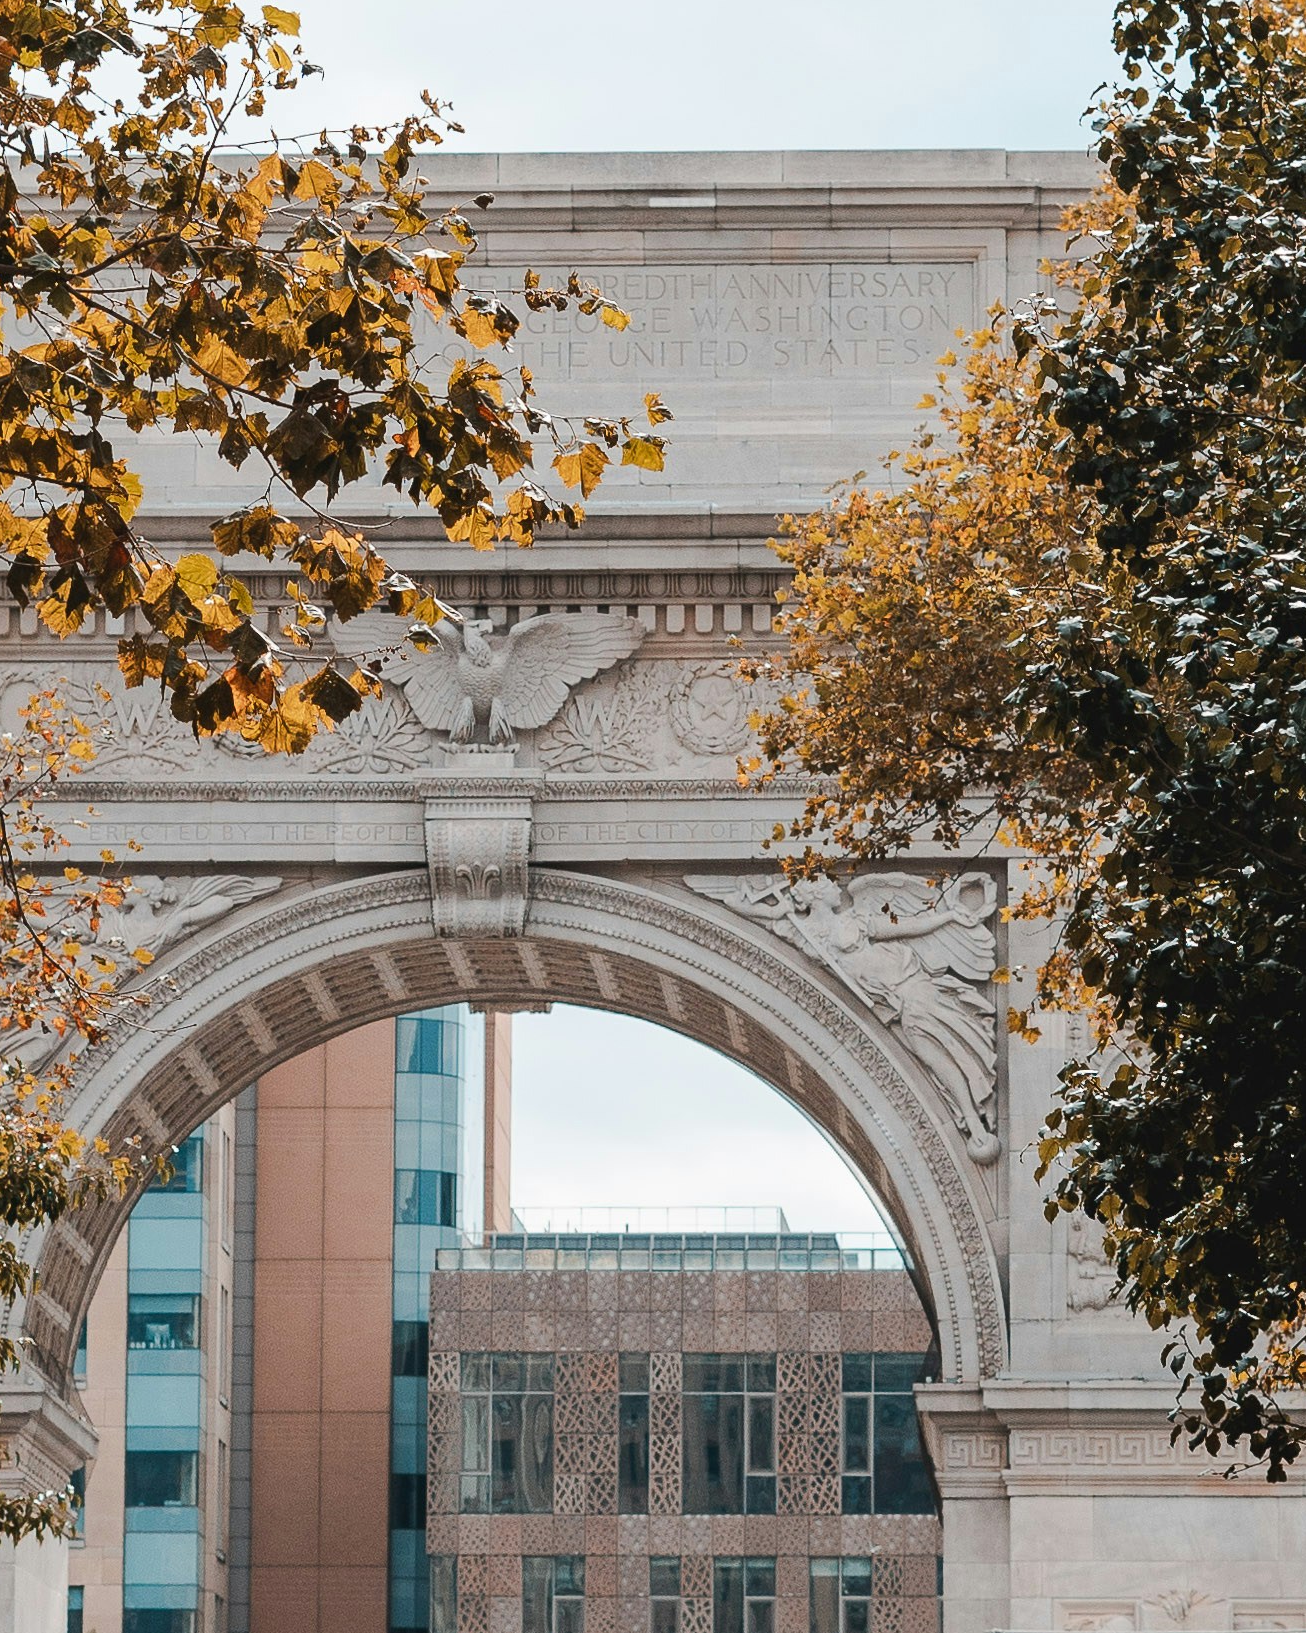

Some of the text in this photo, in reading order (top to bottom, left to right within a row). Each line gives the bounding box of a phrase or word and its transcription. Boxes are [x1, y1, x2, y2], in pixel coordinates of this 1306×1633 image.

[722, 271, 956, 299] ANNIVERSARY
[526, 304, 951, 334] GEOGE WASHINGTON
[513, 341, 589, 367] THE
[609, 340, 749, 367] UNITED
[89, 824, 209, 842] ERECTED
[222, 824, 253, 842] BY
[266, 824, 315, 841] THE
[326, 824, 417, 842] PEOPLE
[540, 824, 570, 841] OF
[580, 824, 627, 841] THE
[637, 822, 700, 840] CITY
[710, 821, 740, 839] OF
